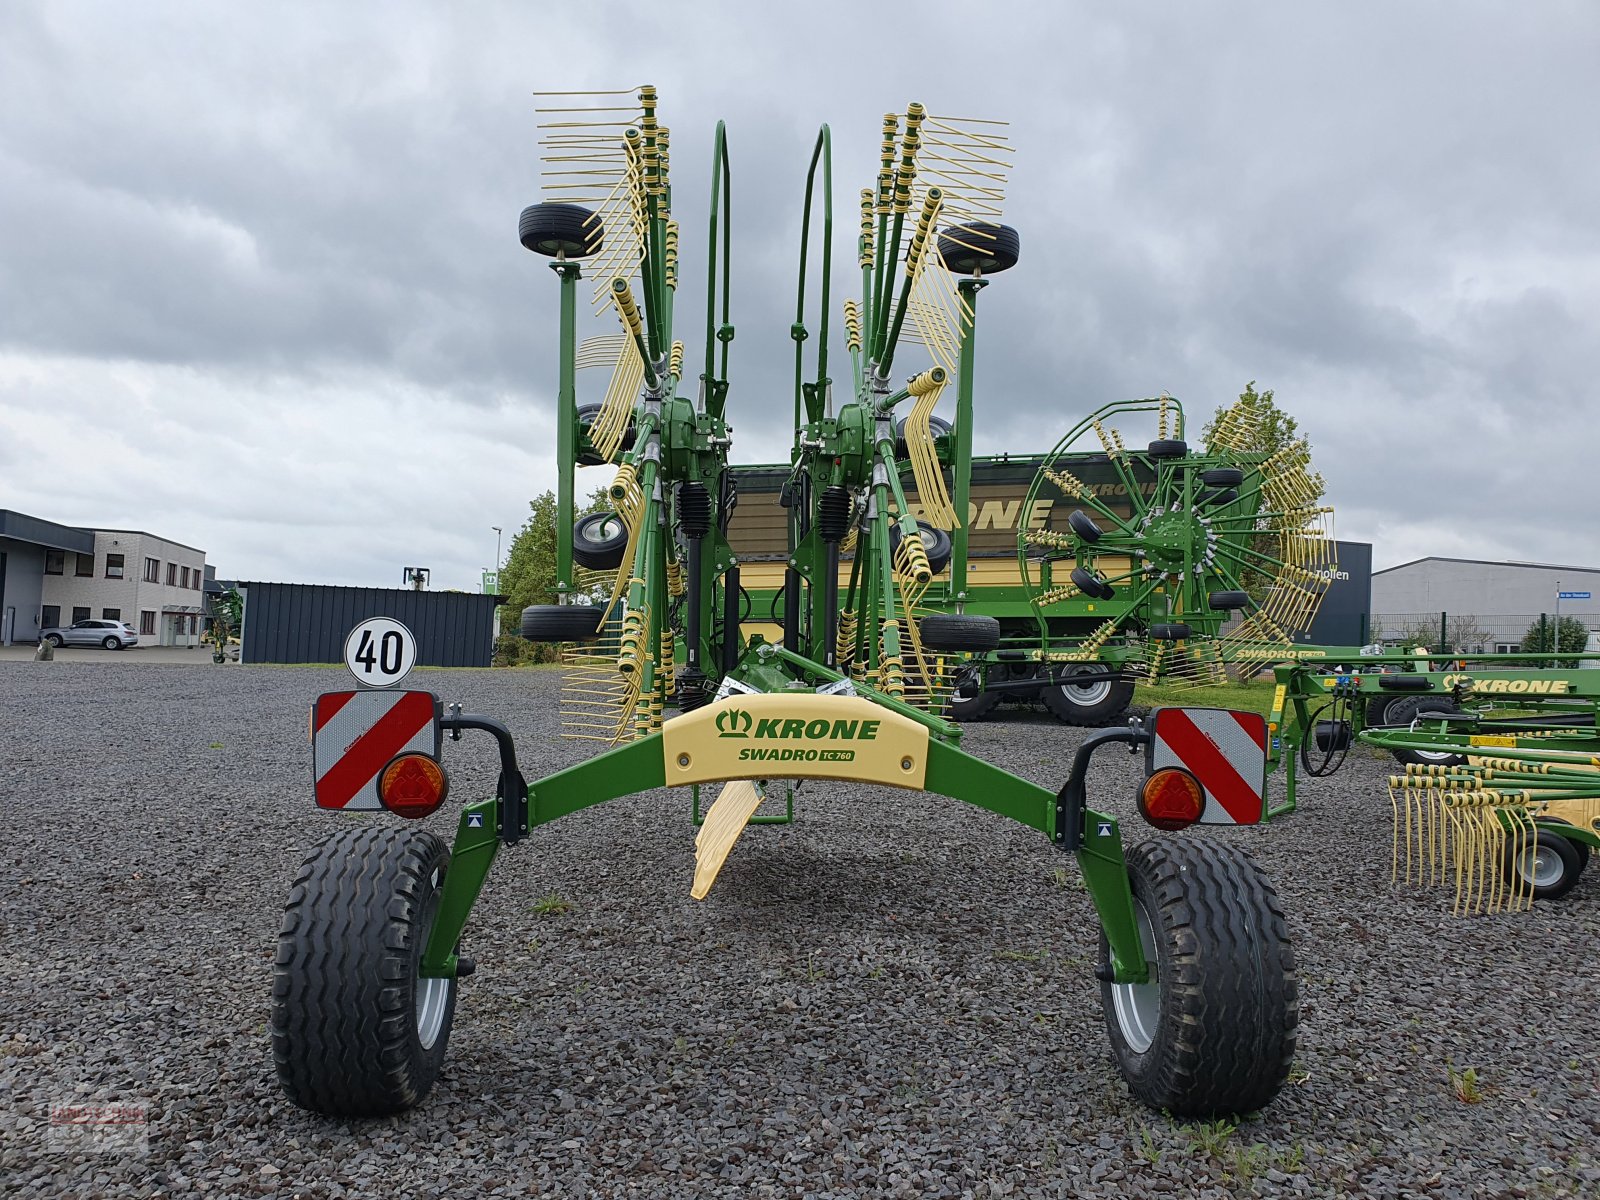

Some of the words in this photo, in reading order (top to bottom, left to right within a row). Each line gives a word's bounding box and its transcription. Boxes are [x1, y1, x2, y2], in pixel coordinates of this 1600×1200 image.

[355, 630, 403, 675] 40
[1236, 649, 1296, 659] SWADRO
[1472, 679, 1569, 693] KRONE
[754, 718, 881, 740] KRONE
[738, 748, 818, 761] SWADRO
[823, 752, 834, 760] TC
[835, 752, 851, 760] 760
